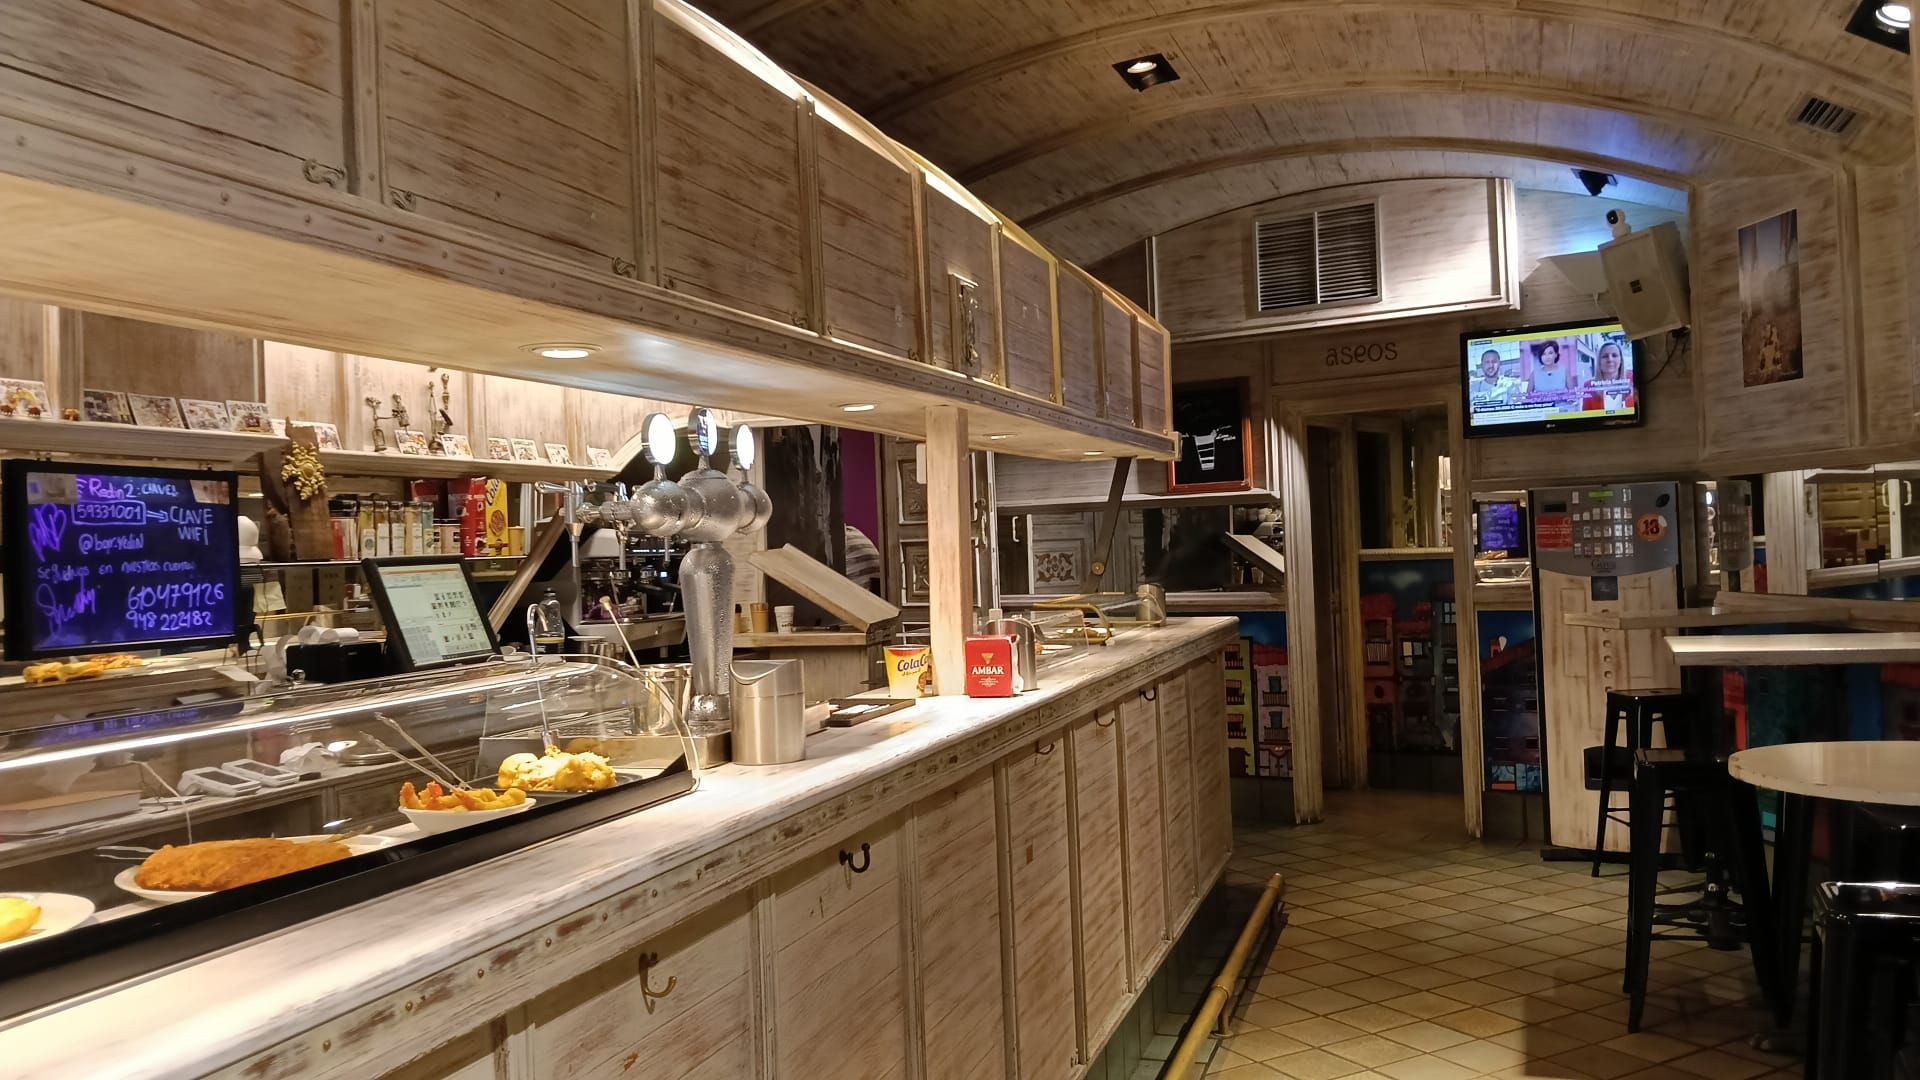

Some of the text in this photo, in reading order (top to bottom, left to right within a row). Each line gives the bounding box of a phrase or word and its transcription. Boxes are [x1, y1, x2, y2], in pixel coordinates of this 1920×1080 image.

[1326, 342, 1398, 367] aseos
[76, 504, 141, 520] 59331001
[169, 506, 213, 525] CLAVE
[127, 582, 225, 611] 610479126
[125, 610, 213, 631] 948 222182
[971, 665, 1005, 676] AMBAR
